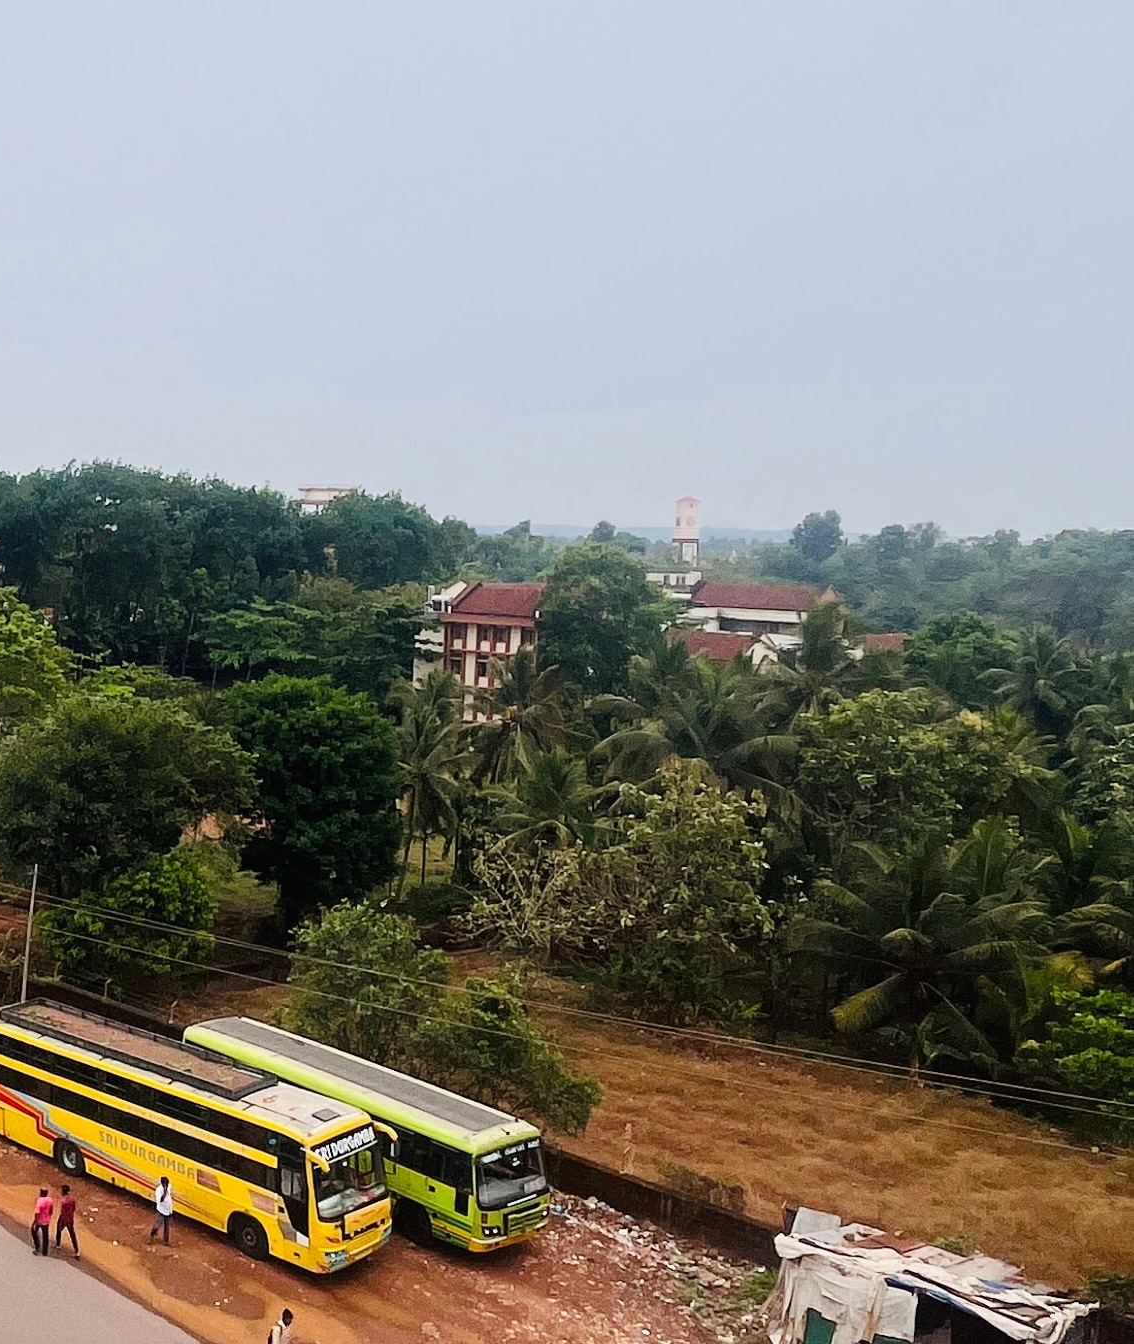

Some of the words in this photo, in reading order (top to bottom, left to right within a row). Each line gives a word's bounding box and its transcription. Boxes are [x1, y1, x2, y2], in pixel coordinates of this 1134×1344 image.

[99, 1131, 118, 1149] SRI
[120, 1139, 195, 1179] DURGAMBA
[330, 1126, 375, 1155] DURGAMBA
